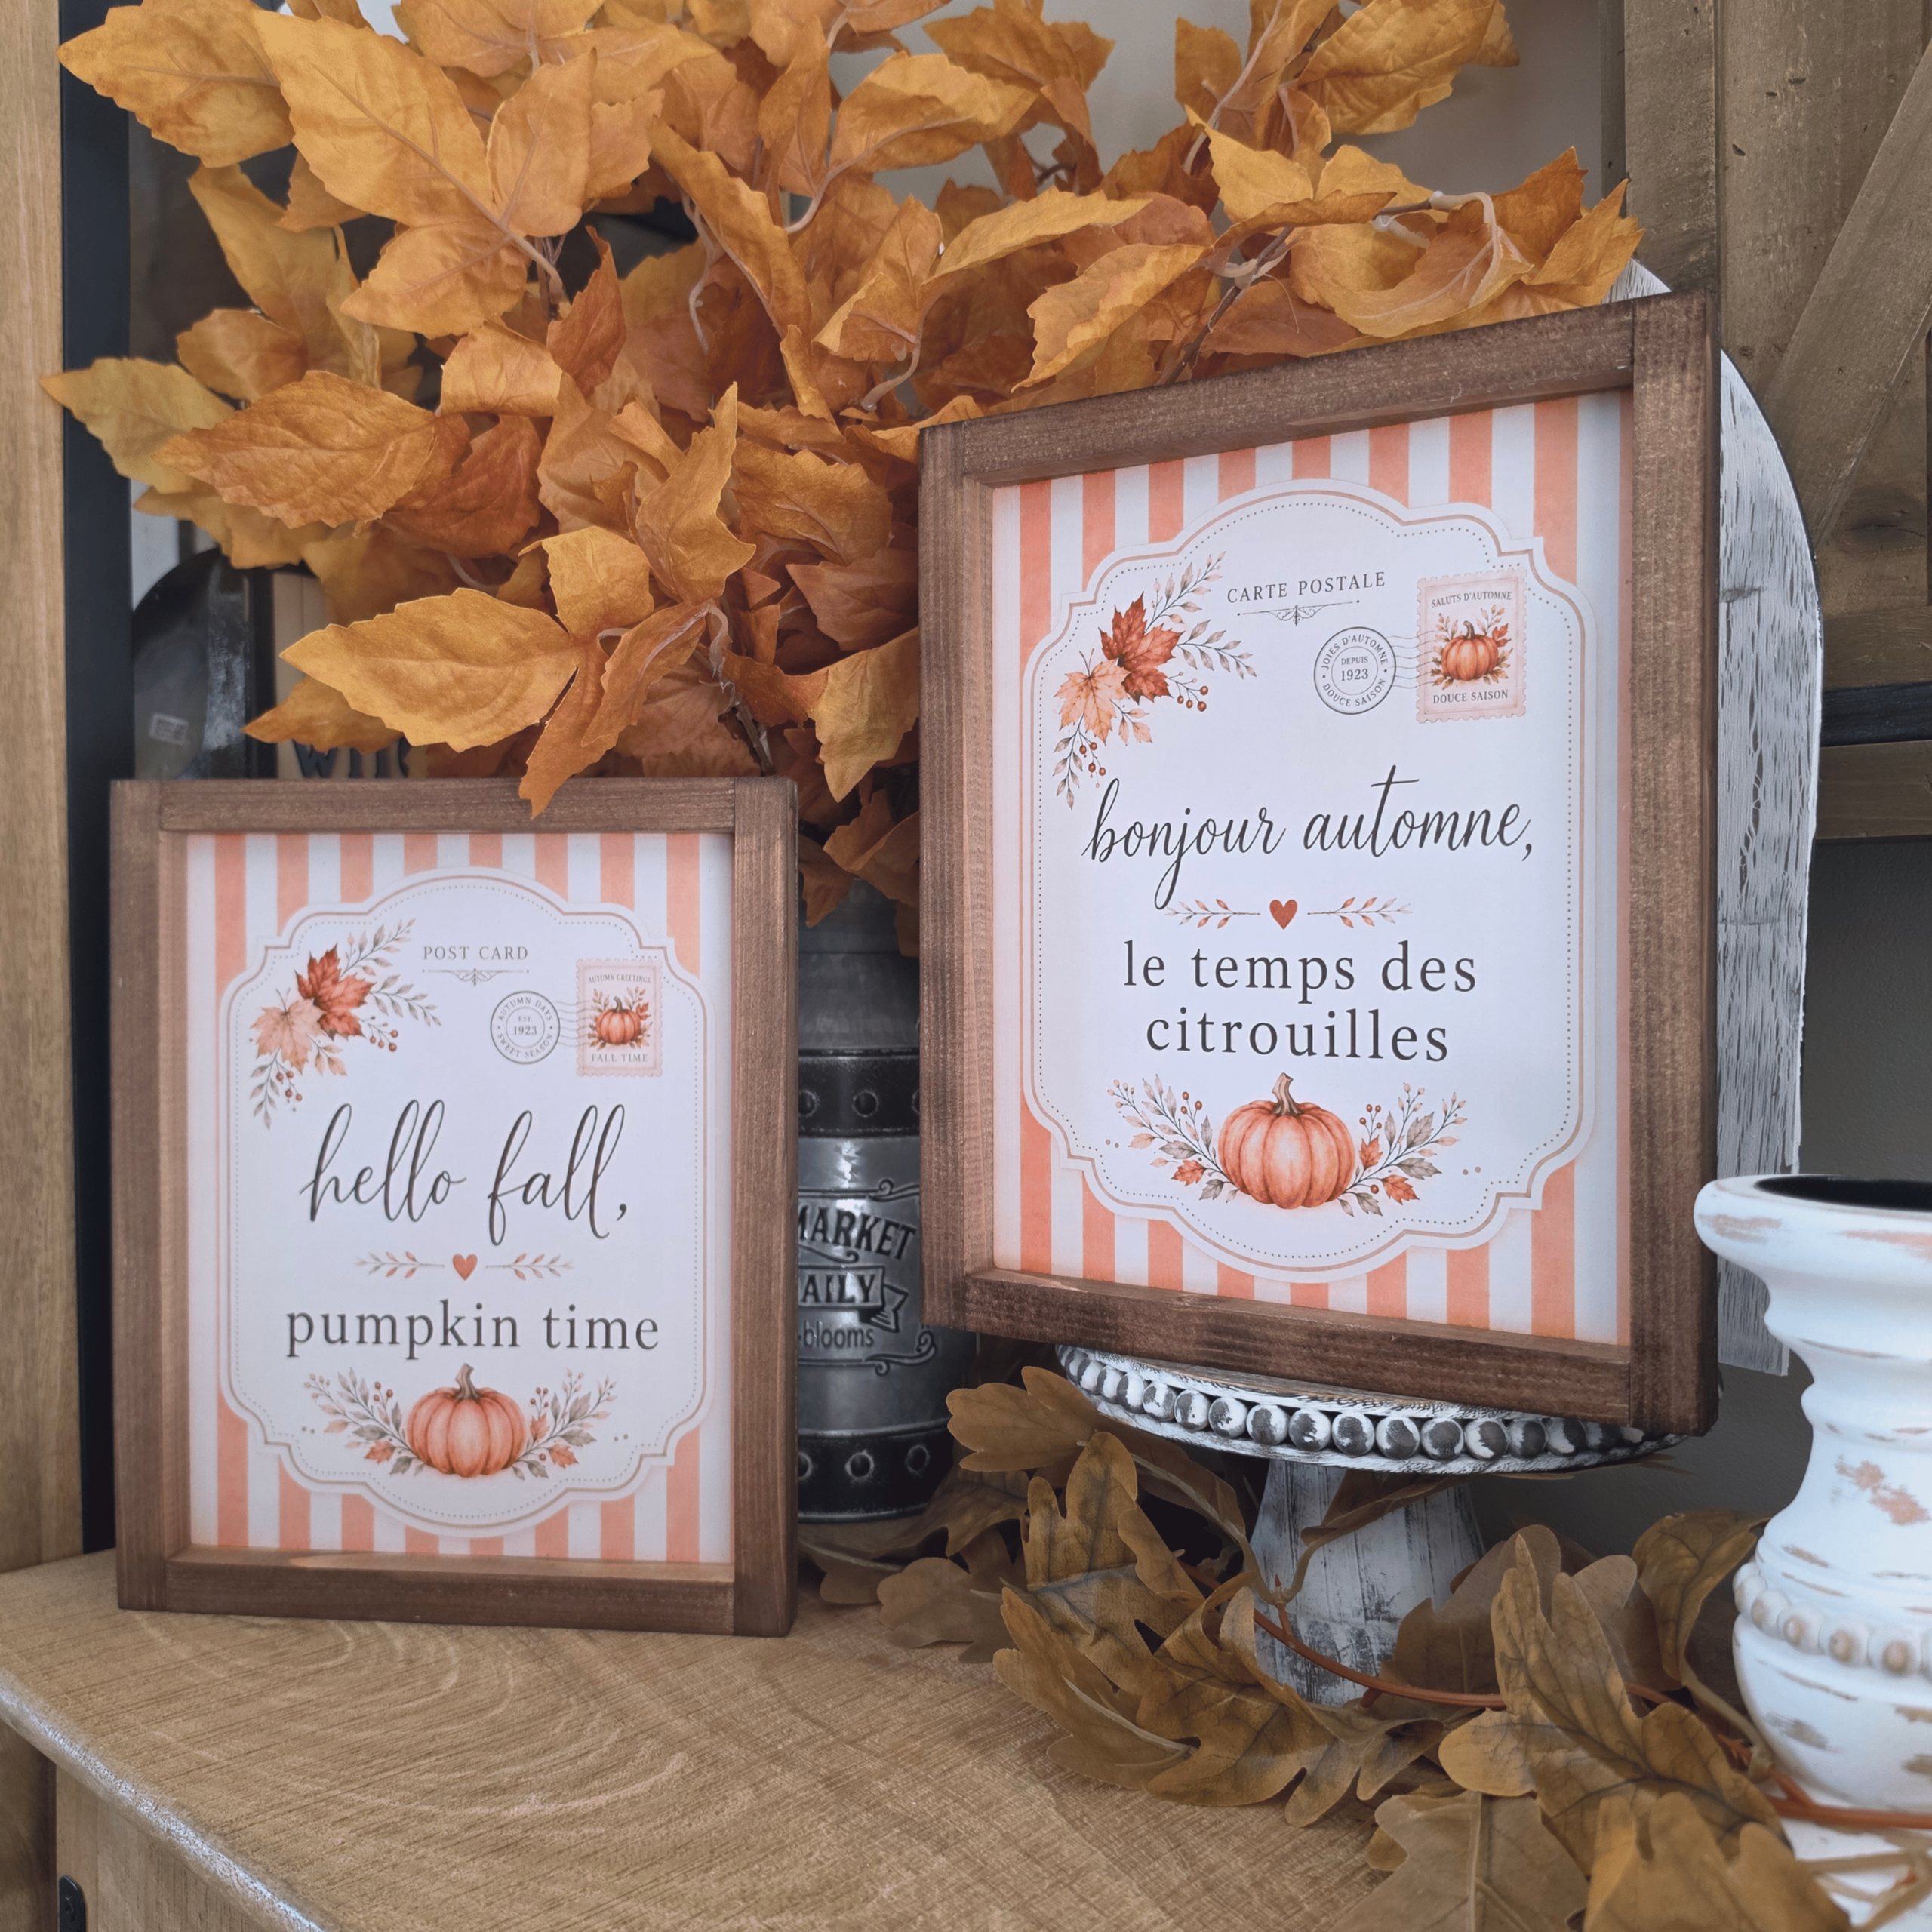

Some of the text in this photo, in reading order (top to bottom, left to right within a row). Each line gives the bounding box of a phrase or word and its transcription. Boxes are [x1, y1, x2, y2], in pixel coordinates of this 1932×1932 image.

[1227, 571, 1386, 603] CARTE POSTALE
[1431, 591, 1512, 608] SALUTS D'AUTOMNE
[1321, 634, 1389, 671] JOIES D'AUTOMNE
[1341, 656, 1369, 666] DEPUIS
[1340, 668, 1369, 681] 1923
[1322, 678, 1386, 707] DOUCE SAISON
[1433, 689, 1509, 704] DOUCE SAISON
[1081, 764, 1533, 910] bonjour automne,
[423, 946, 528, 961] POST CARD
[588, 974, 651, 984] AUTUMN GREETINGS
[1124, 940, 1476, 1004] le temps des
[498, 996, 554, 1022] AUTUMN DAYS
[513, 1026, 537, 1036] 1923
[1146, 1006, 1448, 1063] citrouilles
[497, 1032, 554, 1059] SWEET SEASON
[591, 1054, 648, 1063] FALL TIME
[300, 1099, 627, 1247] hello fall,
[799, 1274, 876, 1303] AILY
[286, 1298, 660, 1361] pumpkin time
